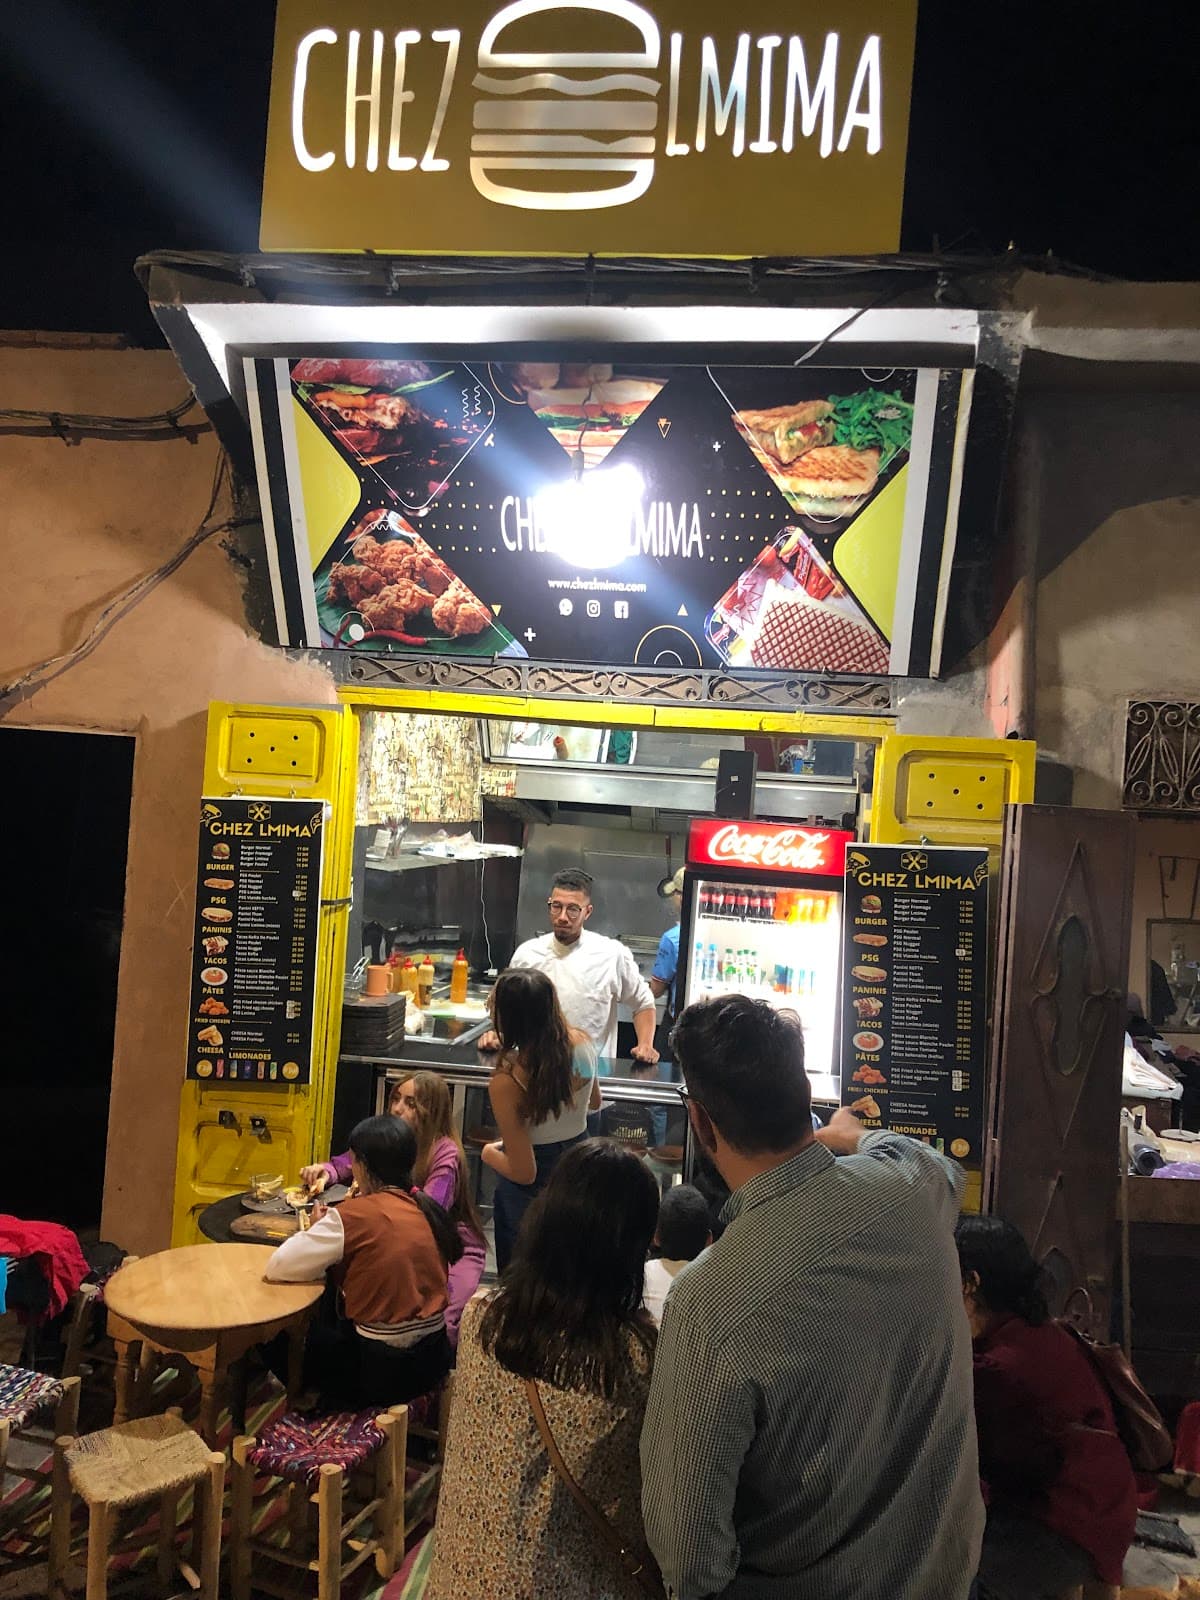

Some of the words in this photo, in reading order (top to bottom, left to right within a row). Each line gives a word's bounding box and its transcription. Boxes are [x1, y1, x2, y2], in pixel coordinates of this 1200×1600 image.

[291, 26, 462, 172] CHEZ
[665, 32, 883, 158] LMIMA
[548, 577, 647, 592] www.chezlmima.com
[210, 822, 254, 836] CHEZ
[260, 823, 311, 838] LMIMA
[206, 863, 234, 871] BURGER
[858, 872, 908, 888] CHEZ
[915, 874, 976, 890] LMIMA
[211, 896, 226, 904] PSG
[854, 917, 887, 926] BURGER
[204, 957, 227, 965] TACOS
[862, 954, 879, 962] PSG
[852, 986, 887, 995] PANINIS
[856, 1020, 882, 1029] TACOS
[229, 1052, 271, 1060] LIMONADES
[856, 1053, 880, 1062] PÂTES
[888, 1125, 937, 1136] LIMONADES
